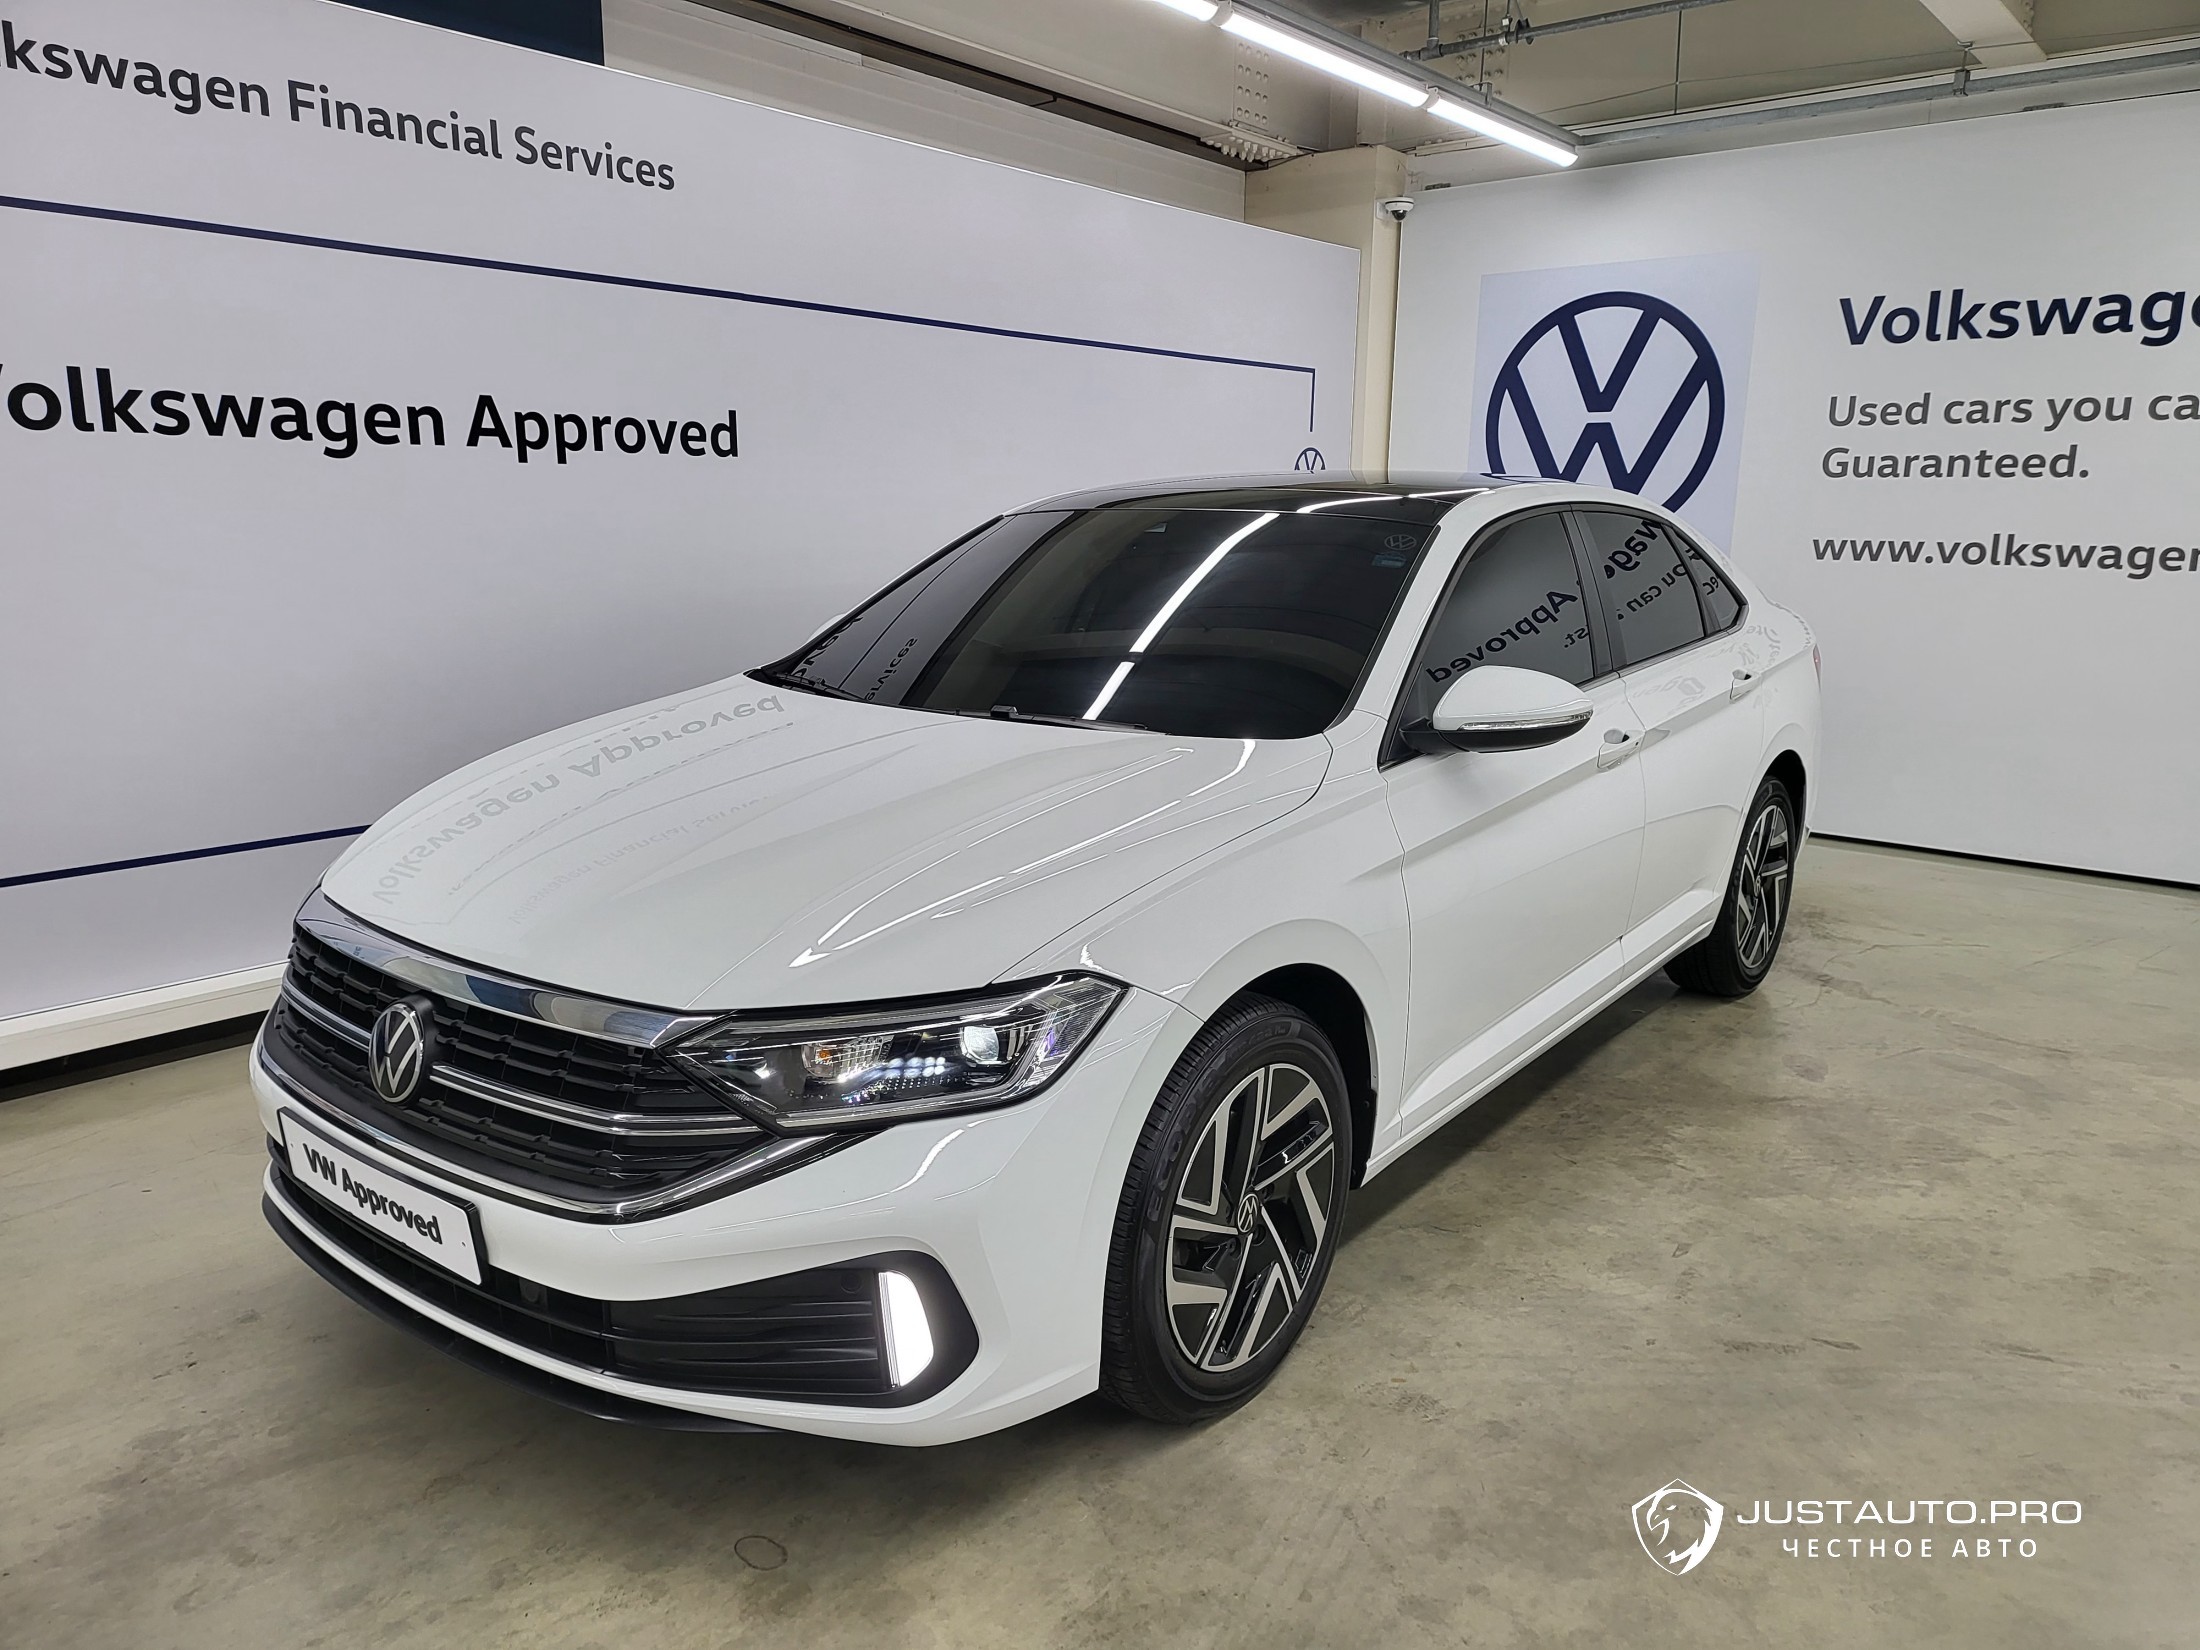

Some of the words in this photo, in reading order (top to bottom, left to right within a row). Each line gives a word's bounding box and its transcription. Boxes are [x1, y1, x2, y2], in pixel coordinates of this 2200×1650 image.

[0, 20, 270, 117] kswagen
[287, 80, 503, 160] Financial
[514, 126, 675, 190] Services
[1839, 289, 2200, 347] Volkswag
[0, 363, 446, 459] olkswagen
[466, 394, 739, 464] Approved
[1828, 393, 1931, 427] Used
[1943, 398, 2034, 425] cars
[2044, 397, 2133, 432] you
[1822, 445, 2089, 479] Guaranteed.
[302, 1142, 337, 1186] VW
[341, 1167, 443, 1245] Approved
